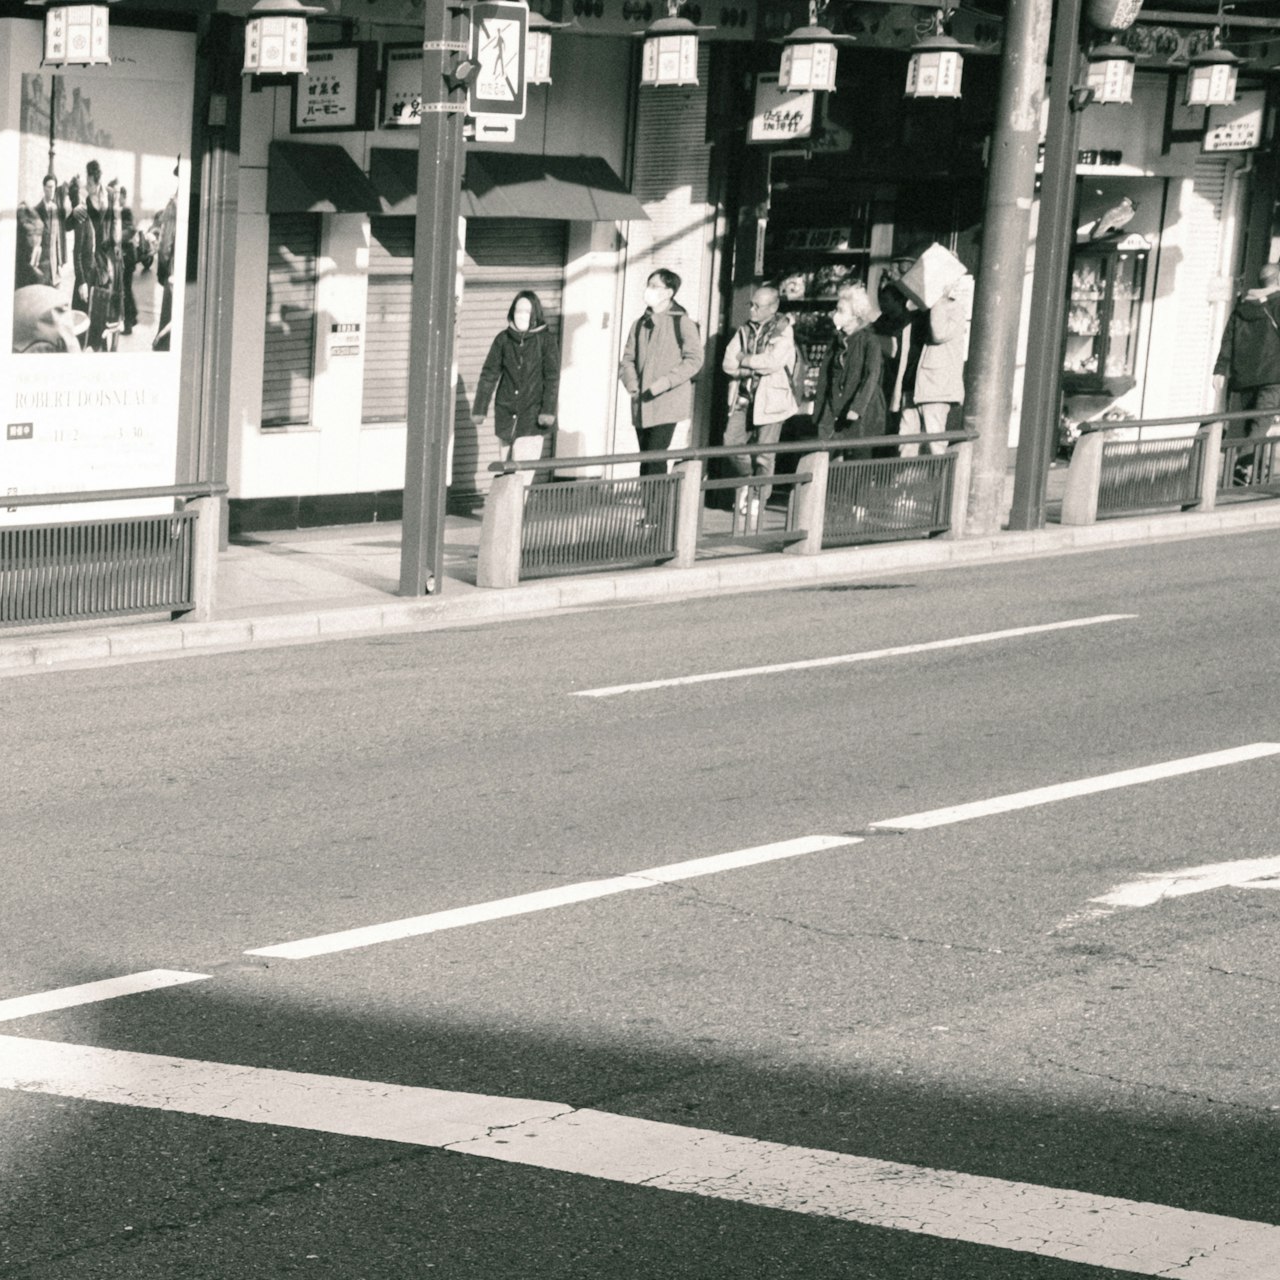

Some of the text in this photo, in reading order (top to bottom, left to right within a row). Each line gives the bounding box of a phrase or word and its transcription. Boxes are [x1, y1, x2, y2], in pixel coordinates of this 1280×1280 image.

[307, 104, 346, 115] ハーモニー
[15, 391, 71, 409] ROBERT
[76, 389, 146, 407] DOISNEAU
